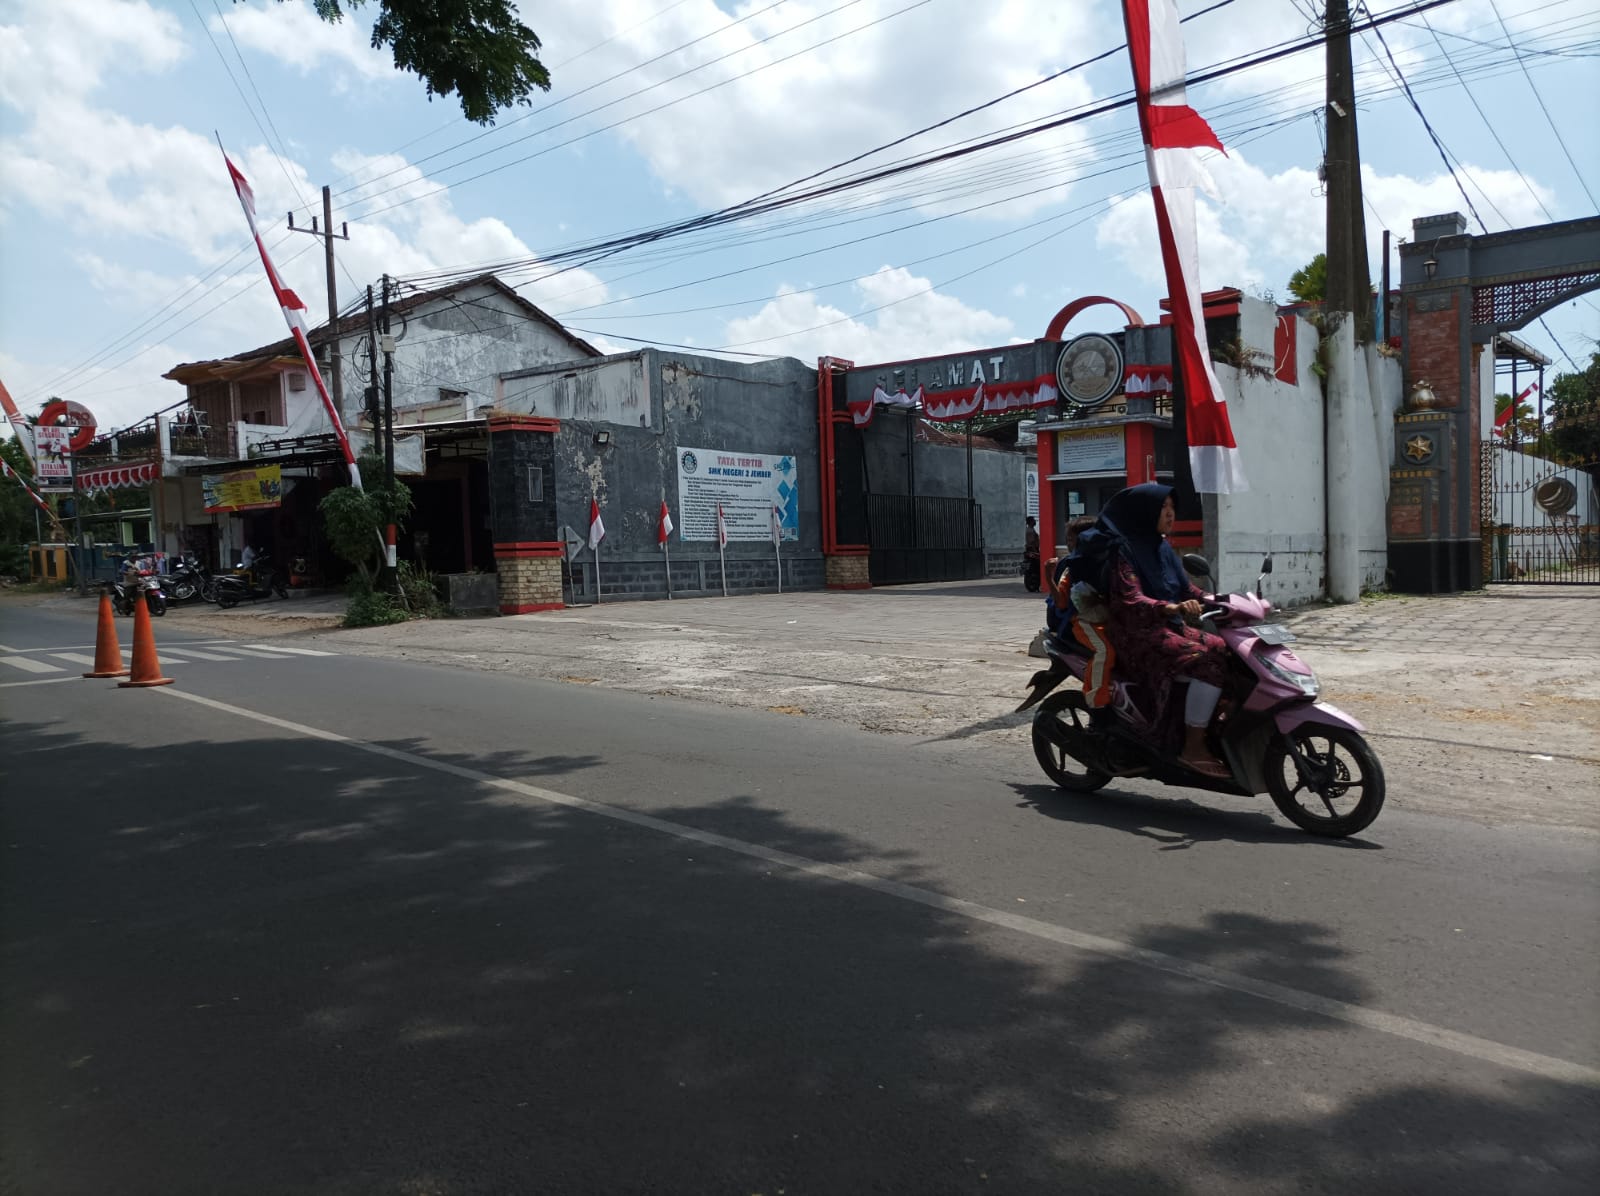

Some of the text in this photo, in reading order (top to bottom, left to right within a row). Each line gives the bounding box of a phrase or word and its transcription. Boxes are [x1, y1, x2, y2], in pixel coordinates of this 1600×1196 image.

[717, 456, 735, 466] TATA
[737, 457, 762, 468] TERTIB
[708, 467, 721, 475] SMK
[722, 468, 744, 477] NEGERI
[750, 470, 772, 478] JEMBER
